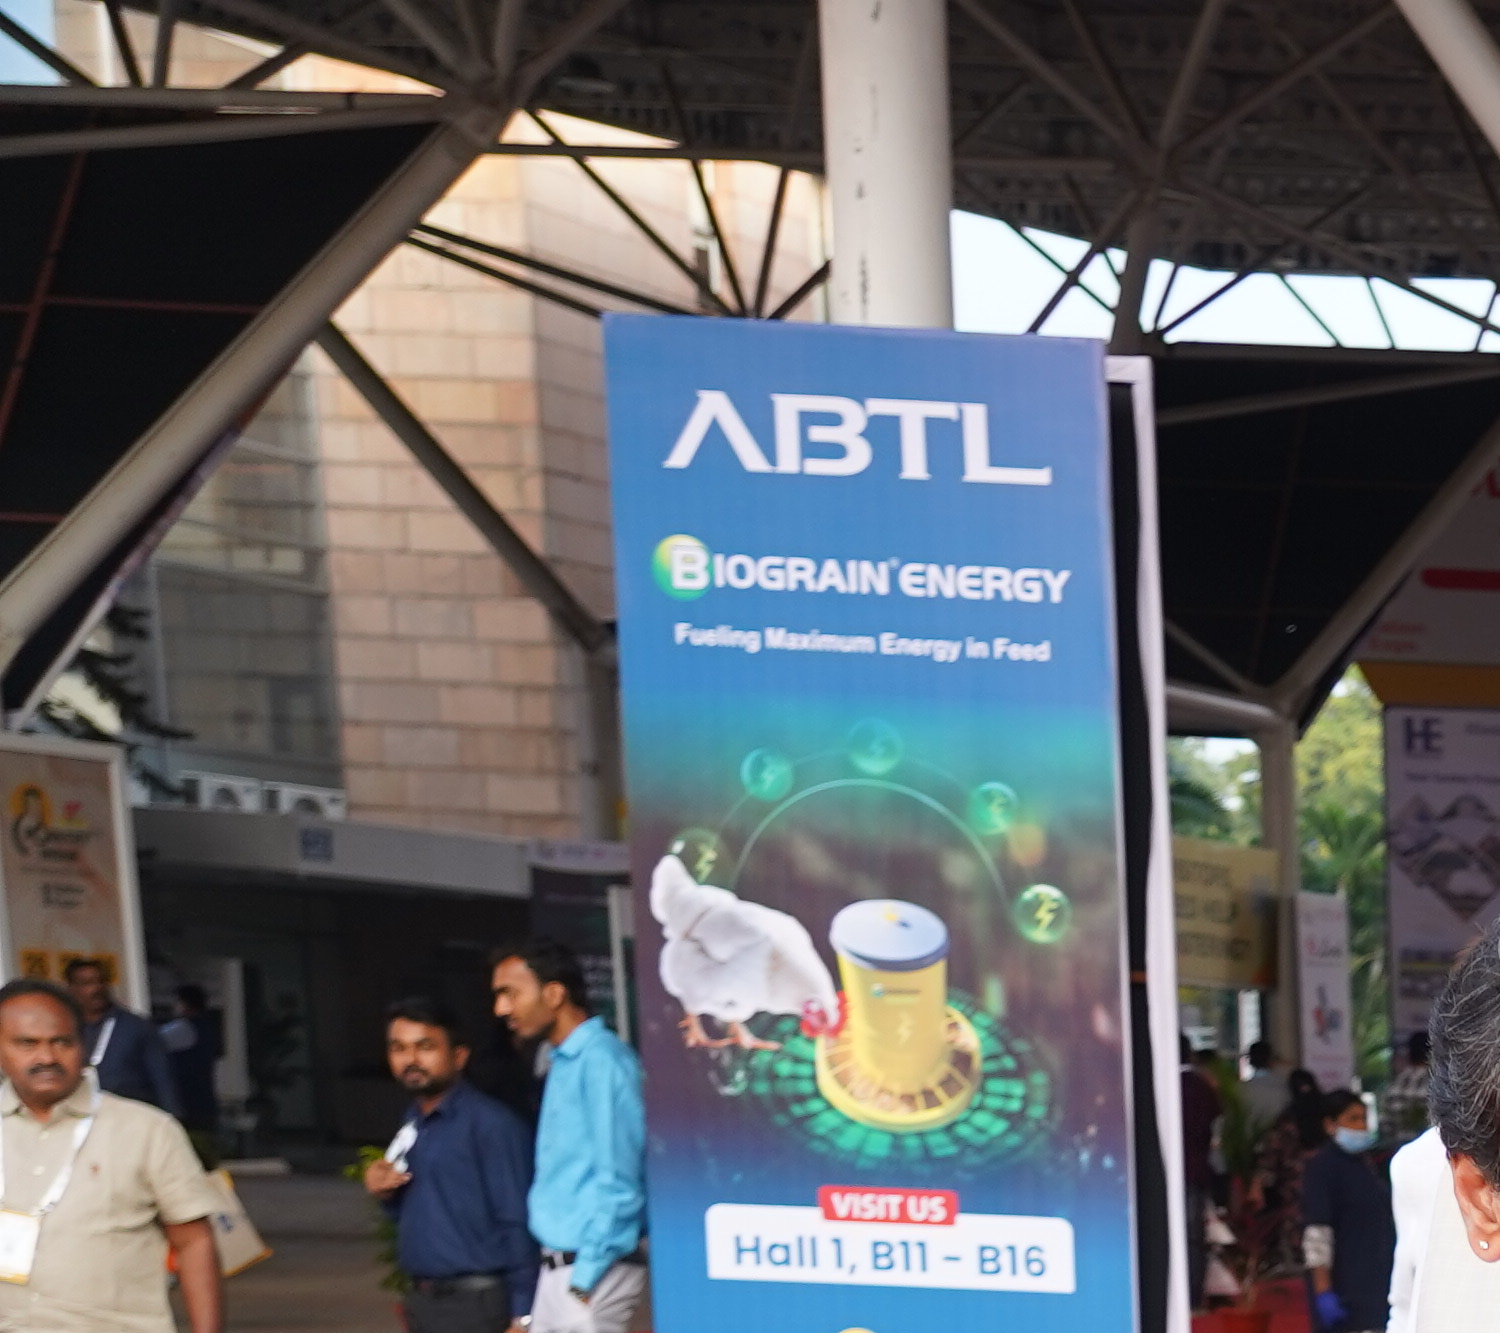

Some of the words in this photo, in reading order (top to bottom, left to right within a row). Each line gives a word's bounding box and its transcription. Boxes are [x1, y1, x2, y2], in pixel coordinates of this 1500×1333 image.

[662, 389, 1053, 486] ABTL
[670, 543, 891, 596] BIOGRAIN
[899, 562, 1070, 604] ENERGY
[673, 622, 761, 654] Fueling
[764, 626, 877, 654] Maximum
[879, 632, 962, 663] Energy
[966, 636, 989, 659] in
[994, 638, 1051, 662] Feed
[830, 1191, 905, 1221] VISIT
[906, 1195, 947, 1223] US
[734, 1235, 818, 1267] Hall
[831, 1238, 857, 1275] 1,
[871, 1240, 928, 1273] B11
[978, 1245, 1047, 1277] B16
